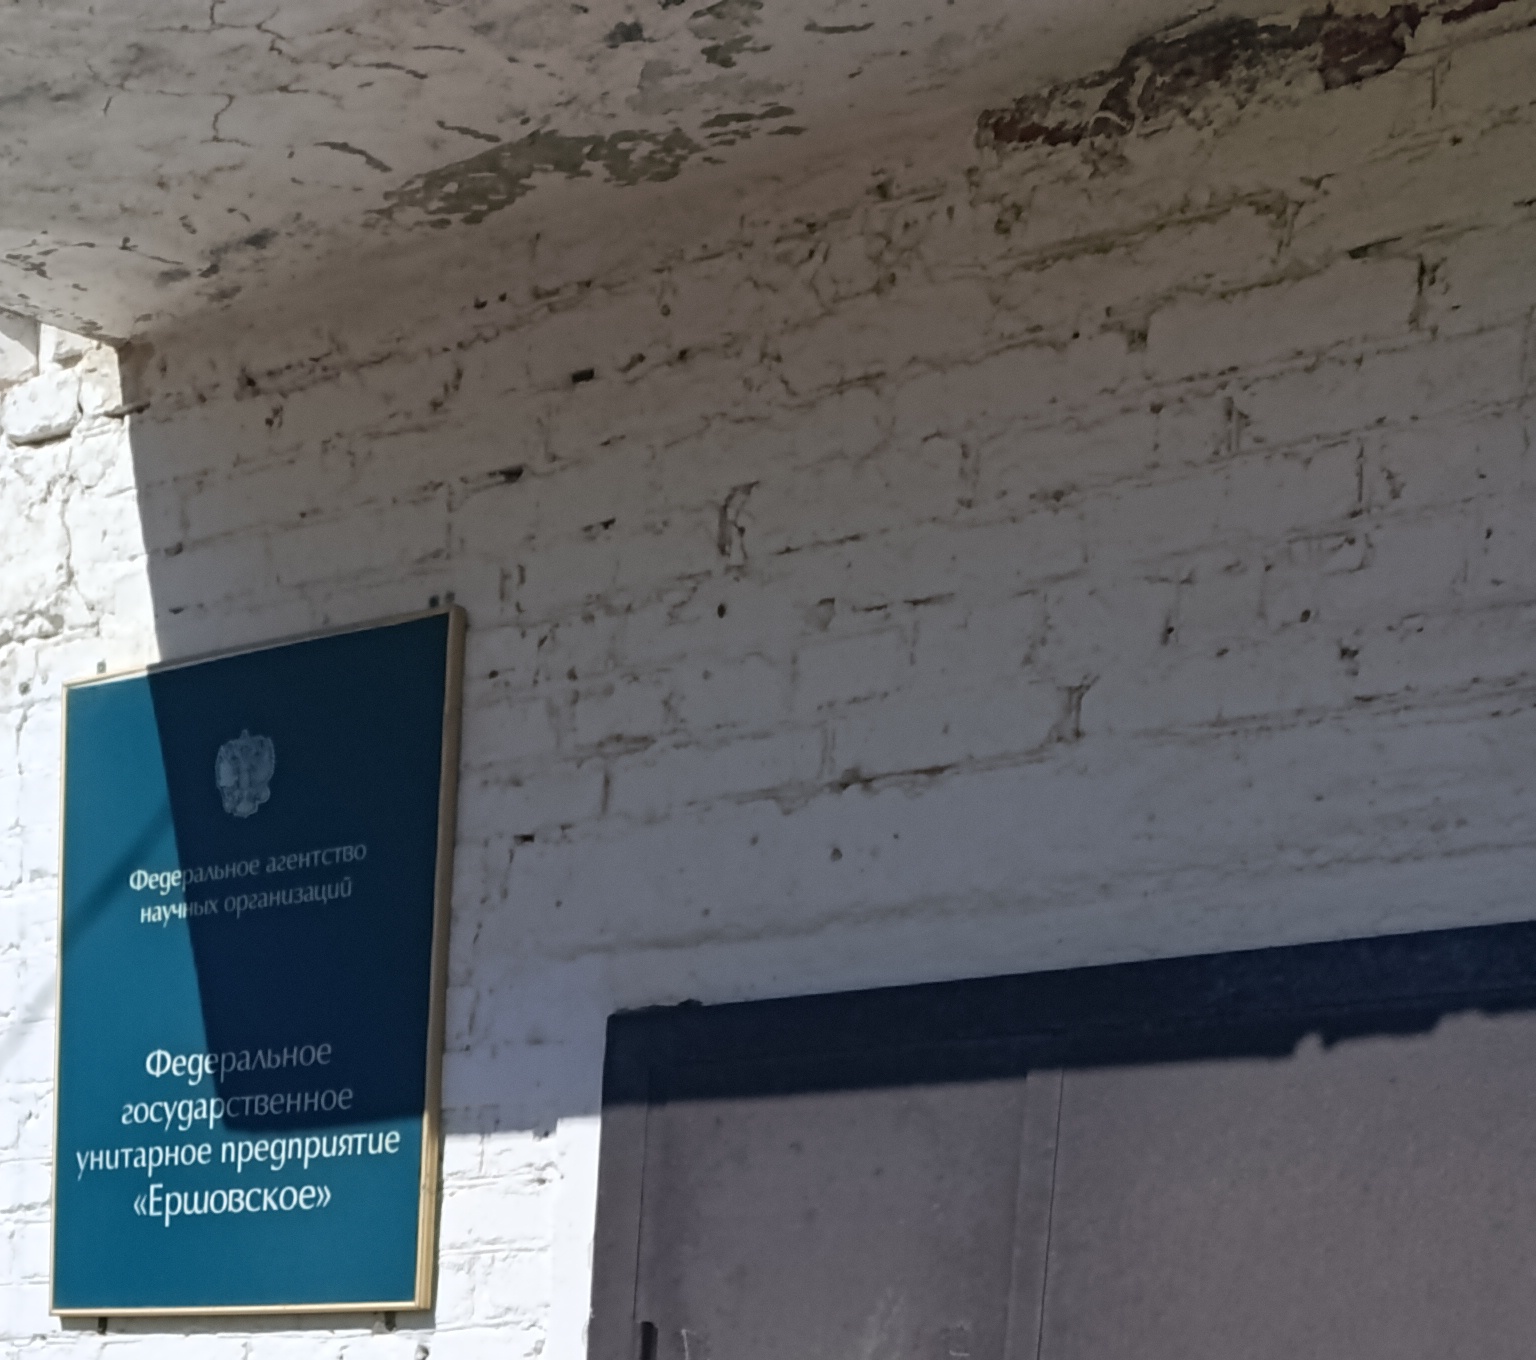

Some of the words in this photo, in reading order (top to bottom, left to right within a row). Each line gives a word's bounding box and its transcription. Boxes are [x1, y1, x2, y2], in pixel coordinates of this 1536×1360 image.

[129, 857, 261, 895] Федеральное
[266, 843, 367, 874] агентство
[140, 895, 219, 927] научных
[224, 876, 353, 919] организаций
[145, 1042, 332, 1086] Федеральное
[120, 1087, 354, 1132] государственное
[75, 1142, 212, 1181] унитарное
[220, 1130, 401, 1173] предприятие
[132, 1182, 331, 1228] «Ершовское»
